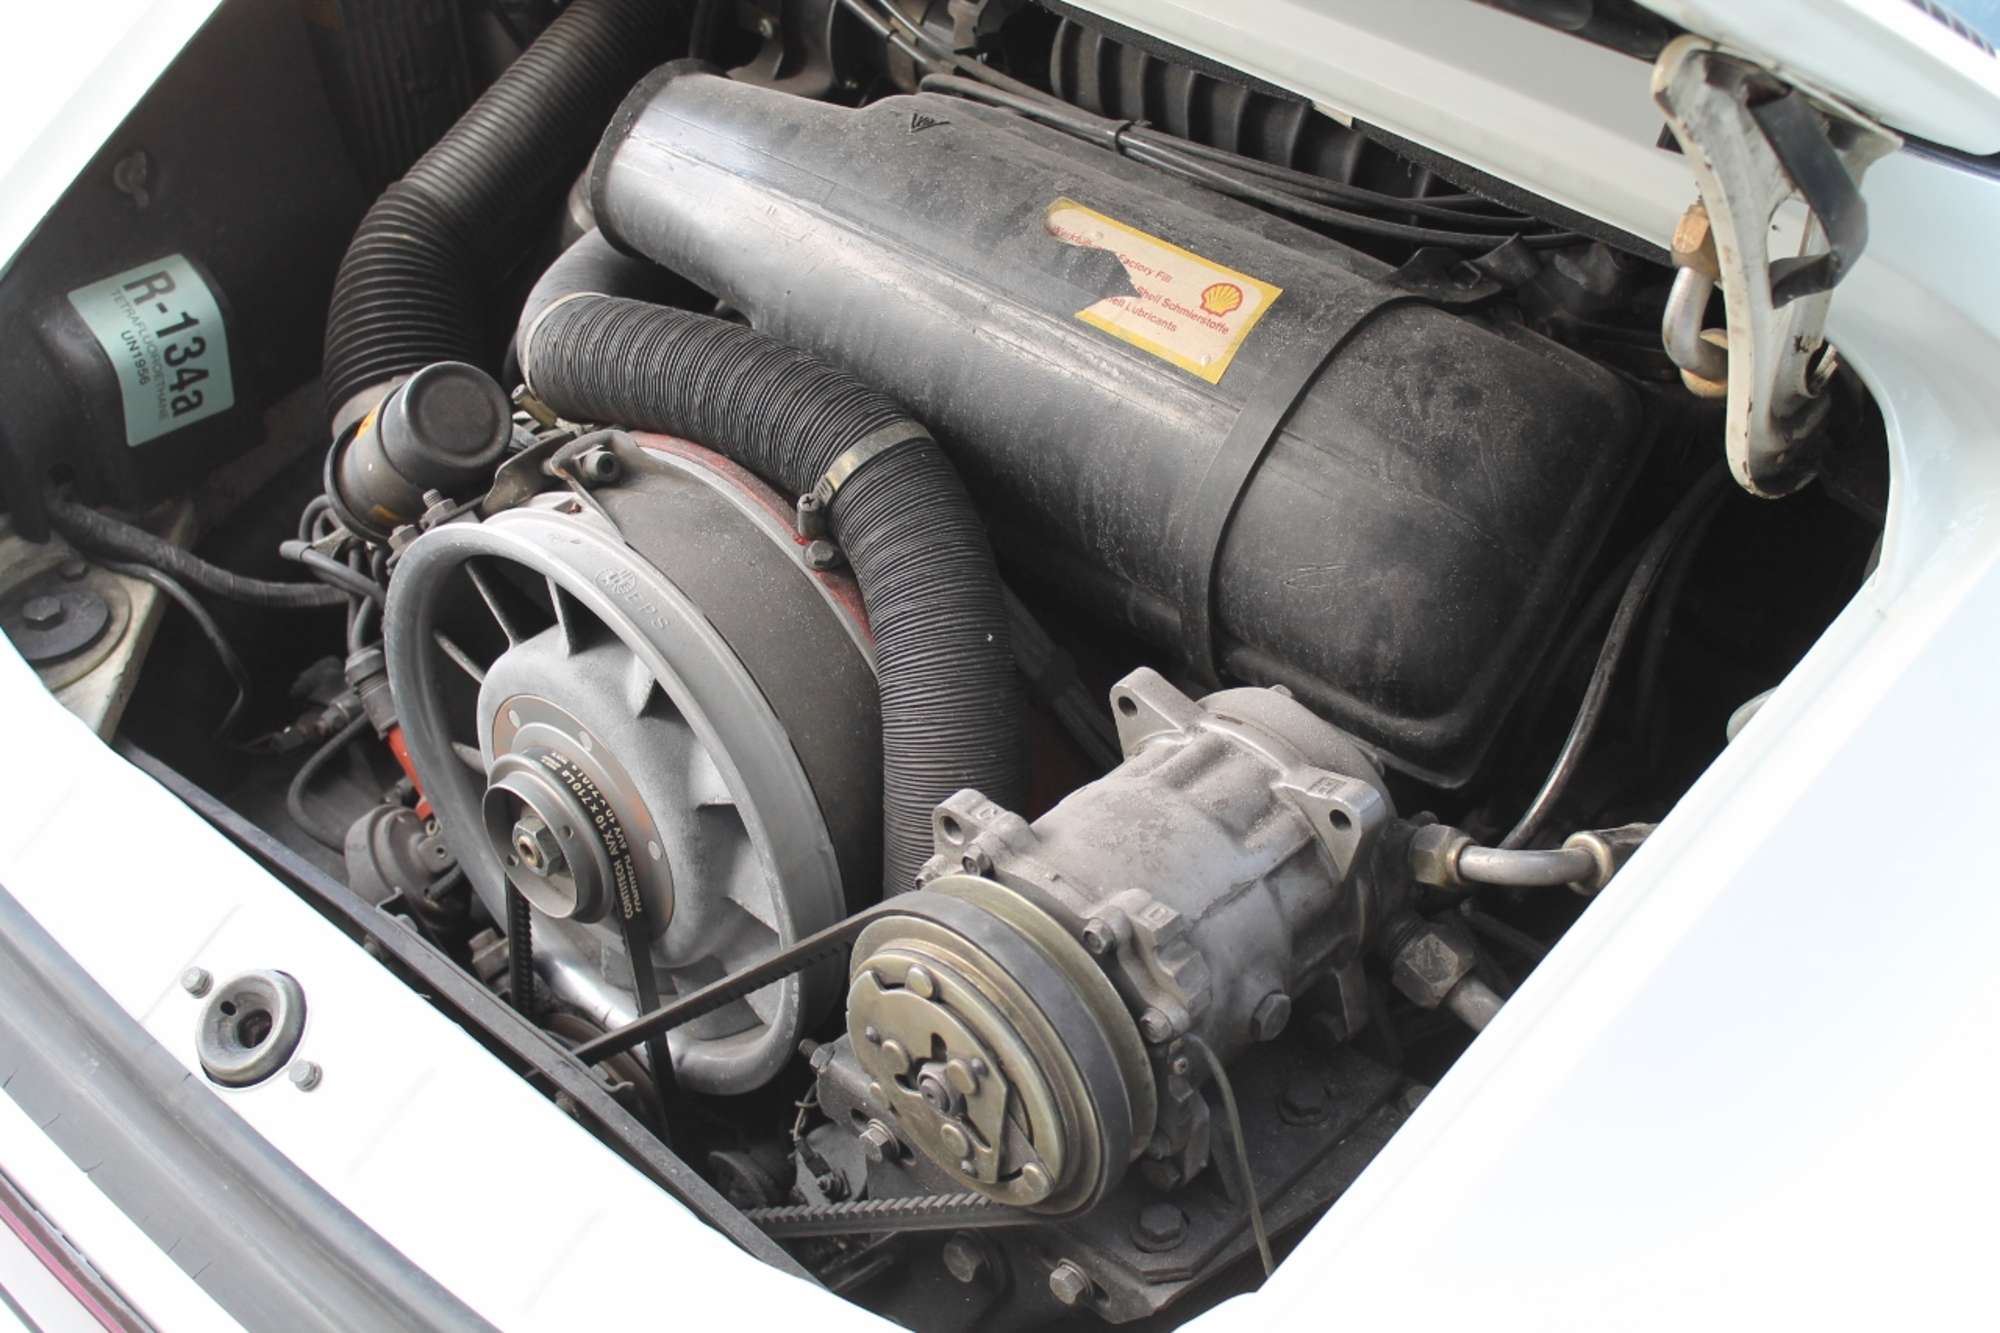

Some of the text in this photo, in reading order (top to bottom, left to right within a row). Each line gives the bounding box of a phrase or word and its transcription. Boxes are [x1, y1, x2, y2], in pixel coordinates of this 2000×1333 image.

[1118, 253, 1173, 284] Factory Fill
[1125, 301, 1178, 333] Lubricants
[1136, 285, 1230, 335] Shell Schmierstoffe
[120, 330, 151, 386] UN1956
[122, 270, 209, 417] R-134a
[595, 815, 607, 830] 10
[603, 829, 620, 856] AVX
[613, 859, 634, 919] CONTITECH
